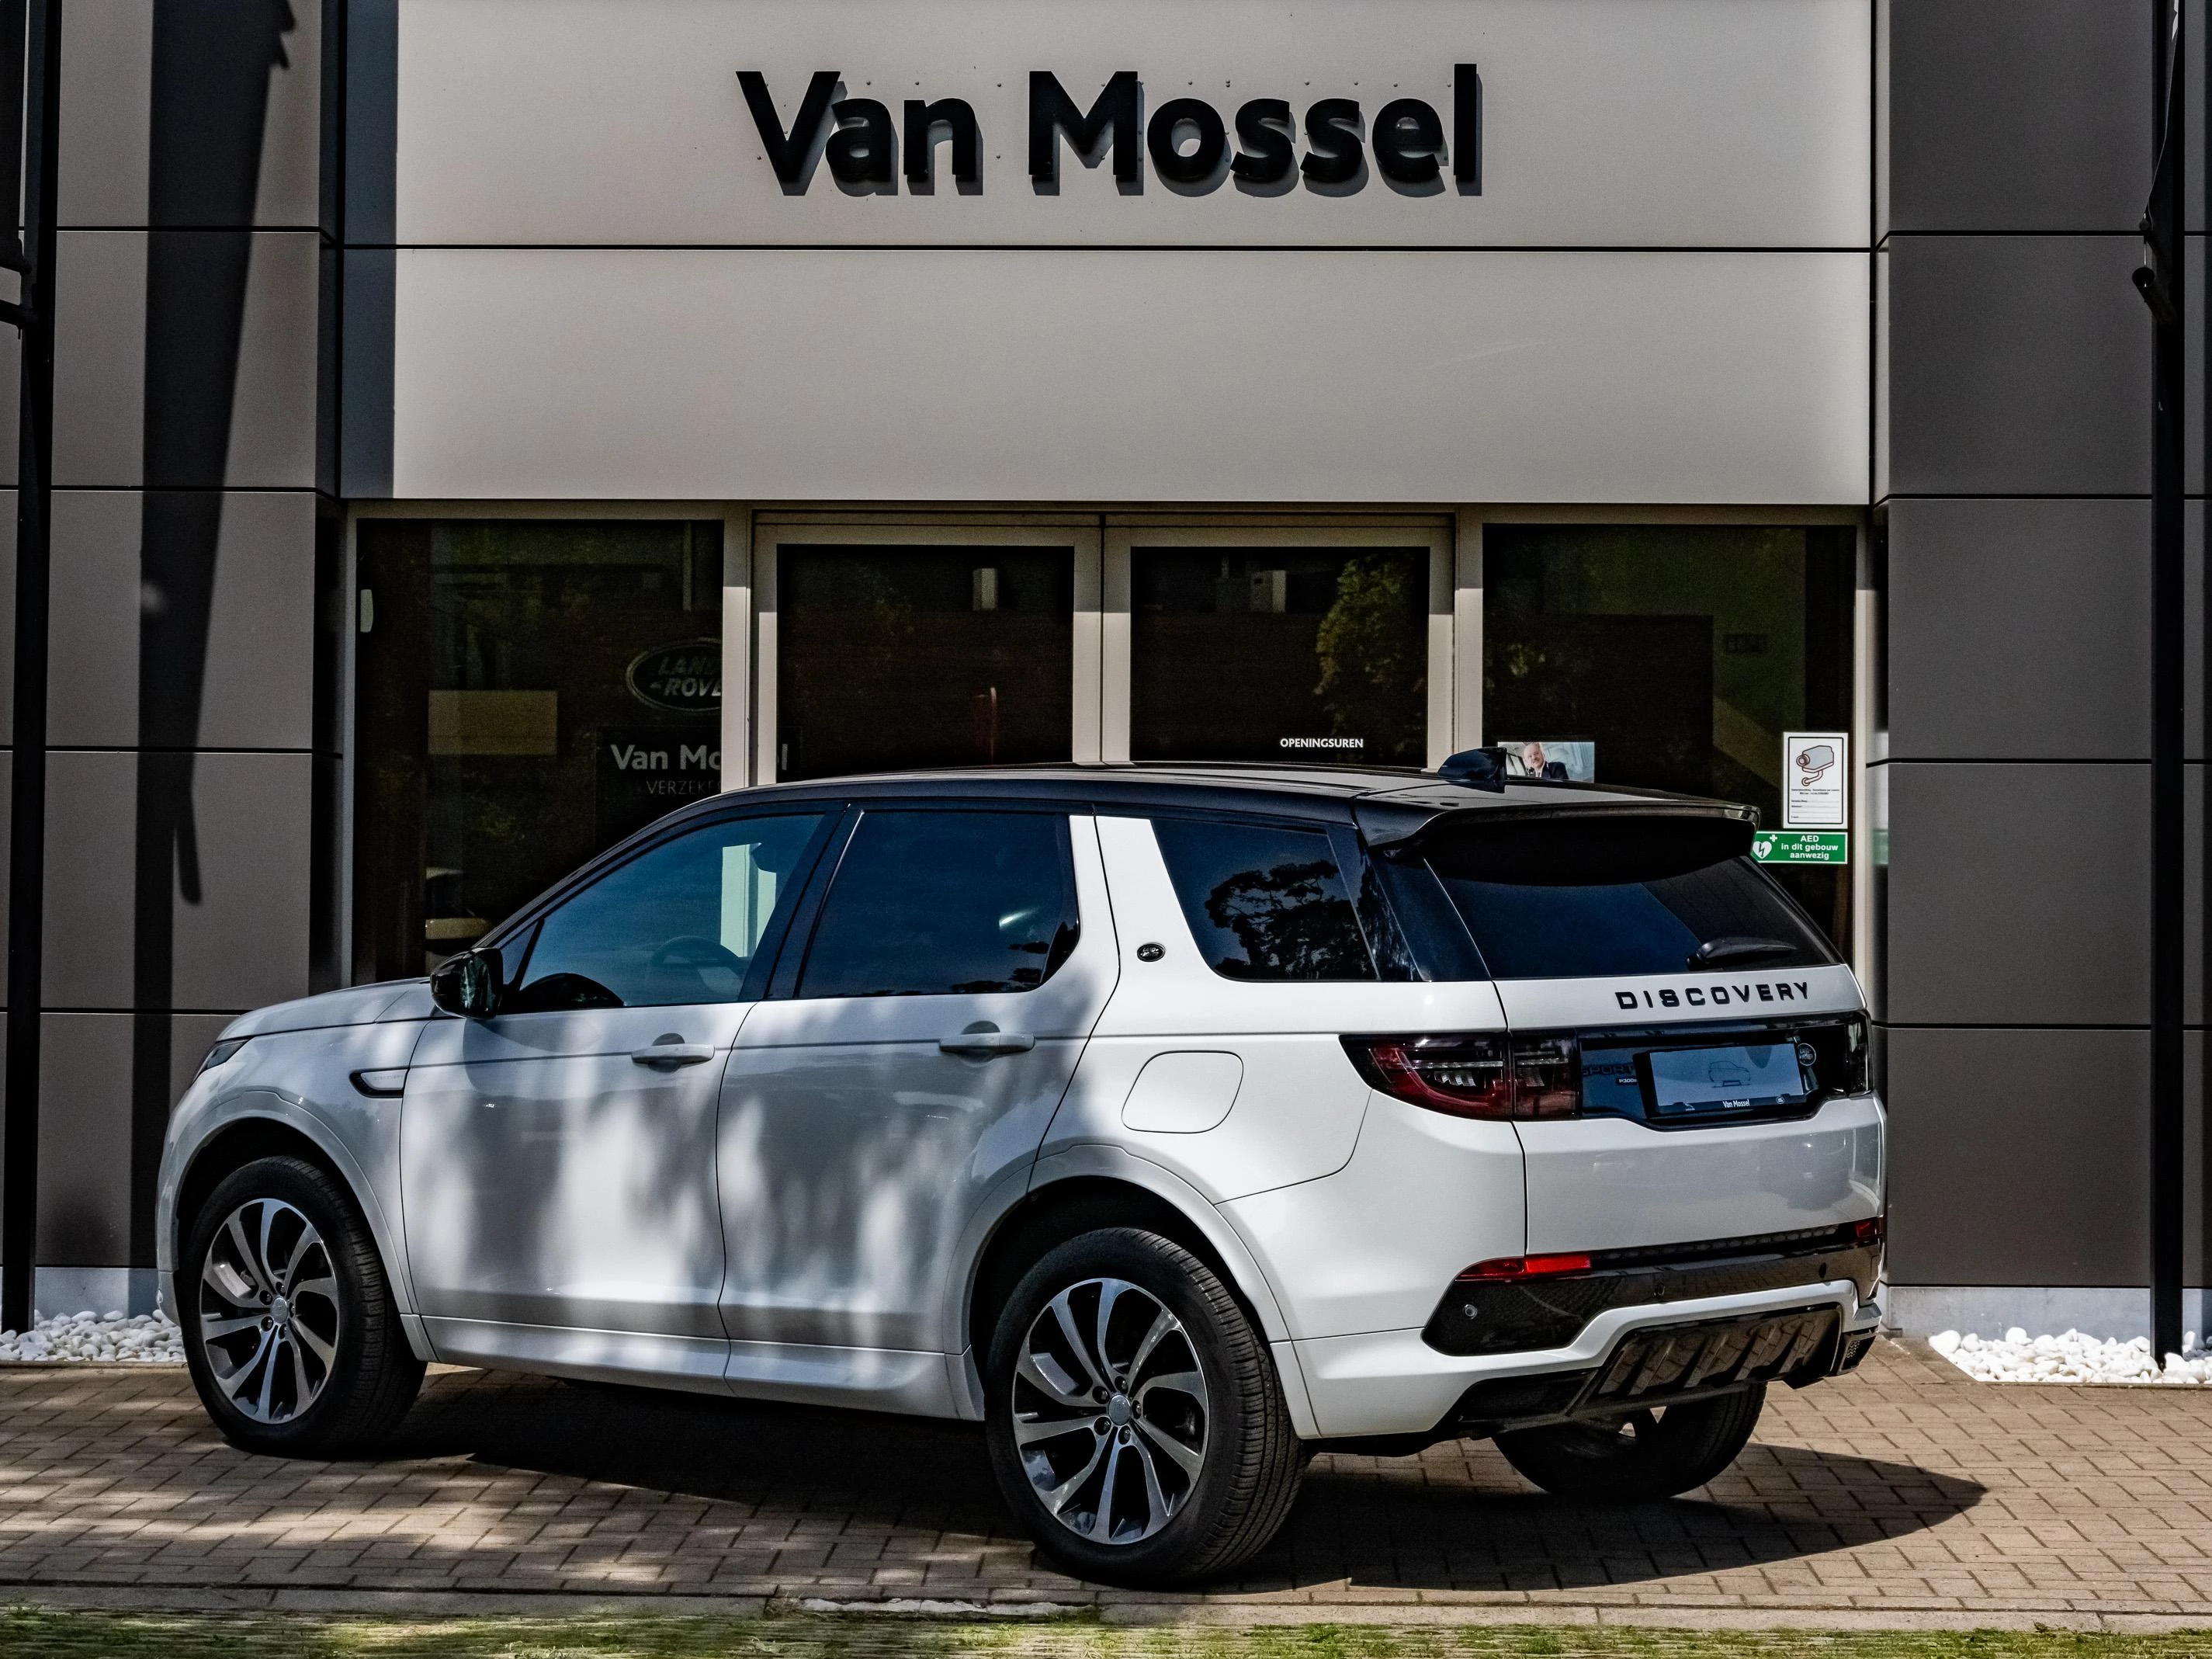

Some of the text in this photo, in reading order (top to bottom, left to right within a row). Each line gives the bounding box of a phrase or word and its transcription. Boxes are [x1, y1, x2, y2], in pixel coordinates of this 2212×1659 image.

[735, 63, 1479, 184] Van Mossel
[664, 677, 722, 697] ROVE
[1280, 738, 1364, 748] OPENINGSUREN
[610, 743, 789, 771] Van Mol
[1805, 844, 1839, 852] gebouw
[1790, 852, 1829, 861] aanwezig
[1614, 981, 1808, 1010] DISCOVERY
[1733, 1098, 1750, 1108] Mossel
